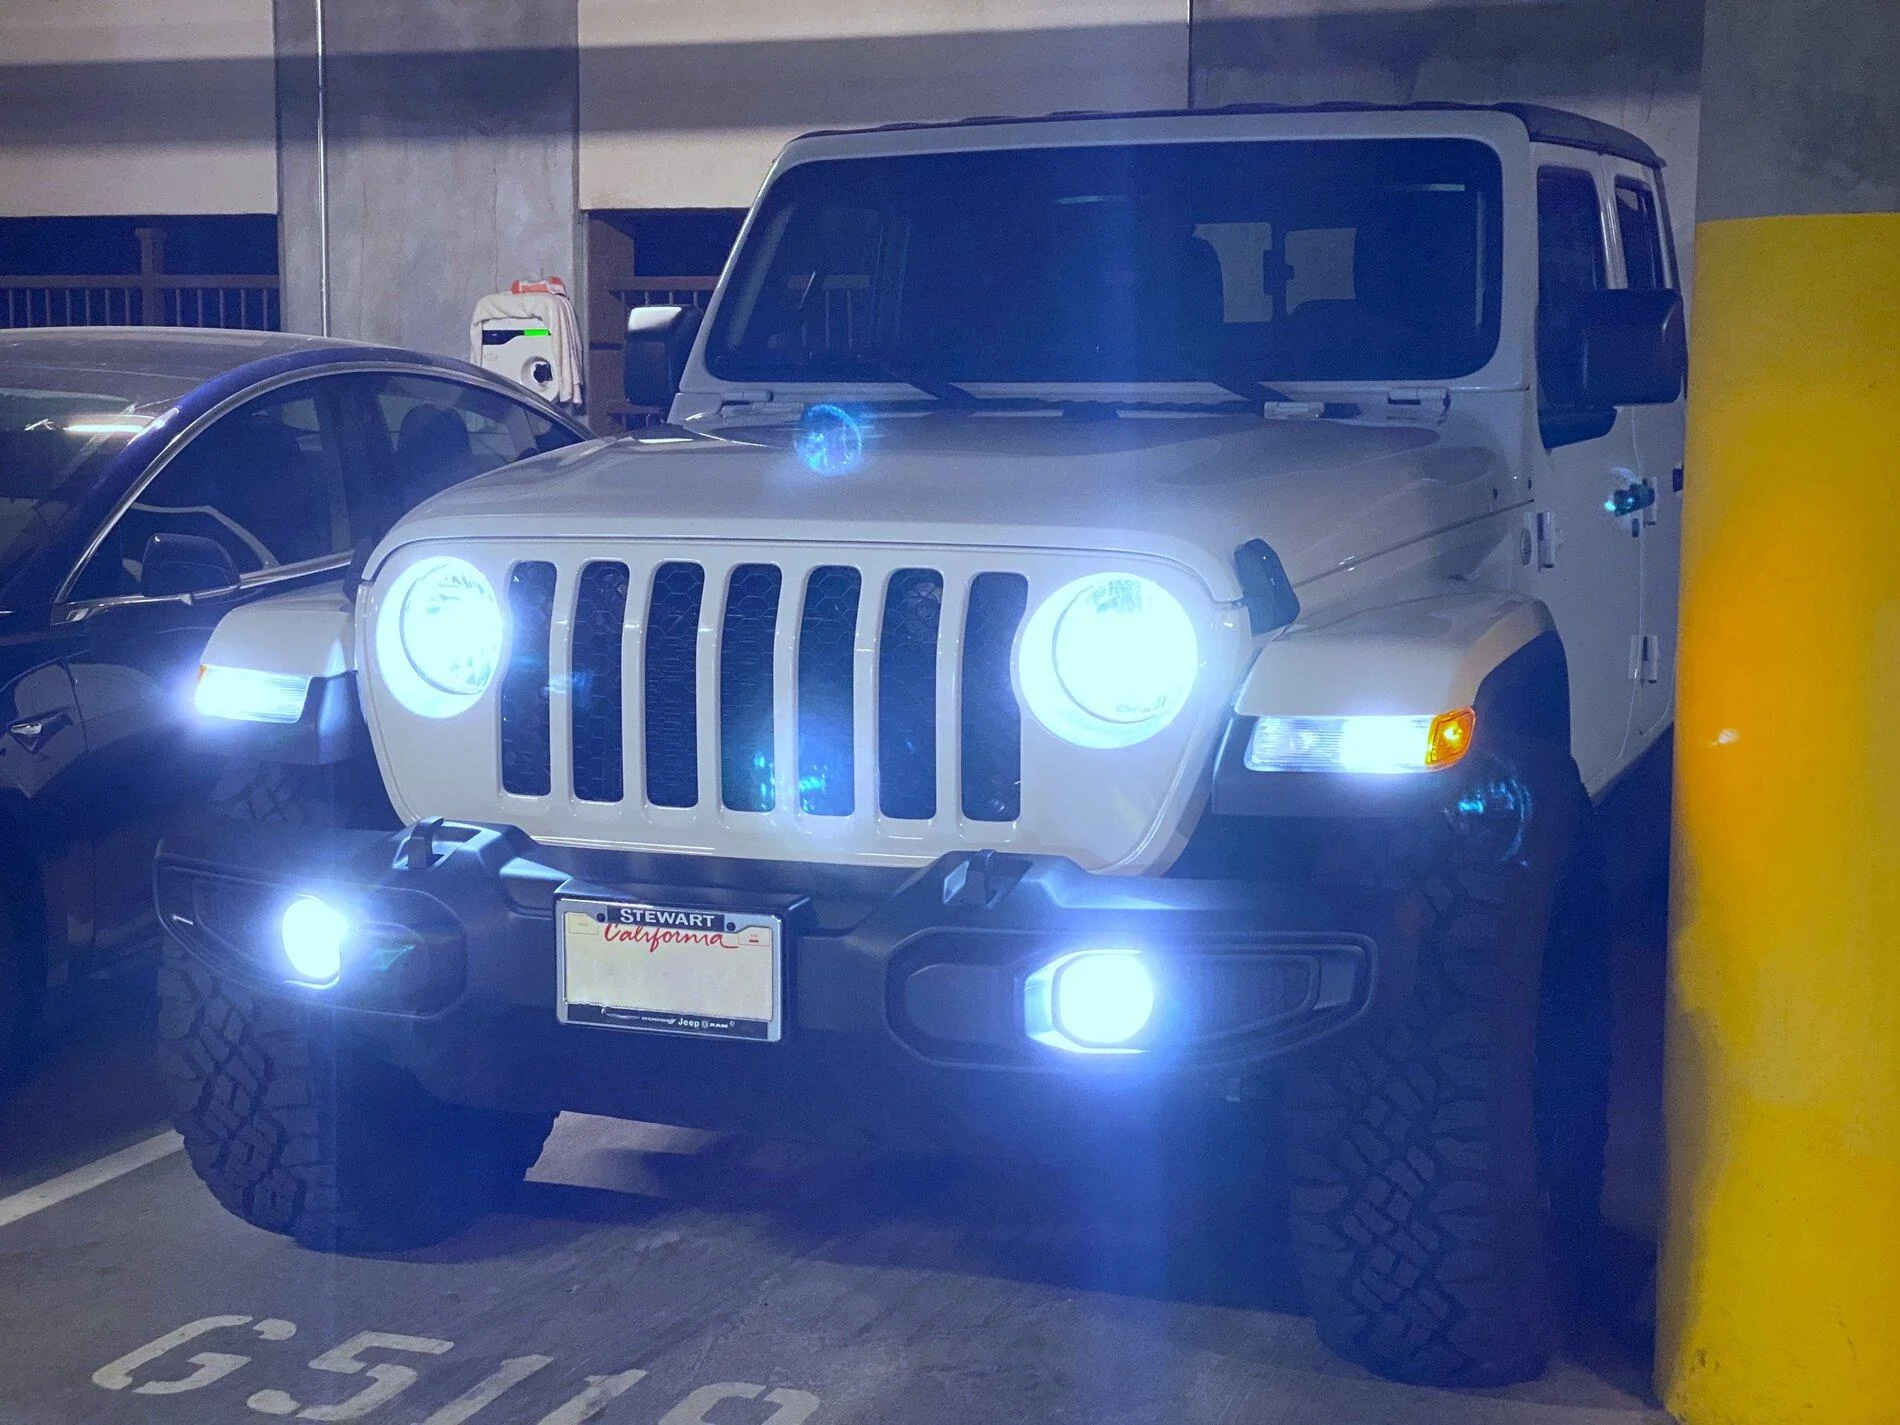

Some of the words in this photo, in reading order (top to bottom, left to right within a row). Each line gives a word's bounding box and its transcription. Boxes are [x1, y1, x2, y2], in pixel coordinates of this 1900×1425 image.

[620, 908, 715, 927] STEWART
[604, 922, 739, 953] California
[677, 1017, 700, 1029] Jeep
